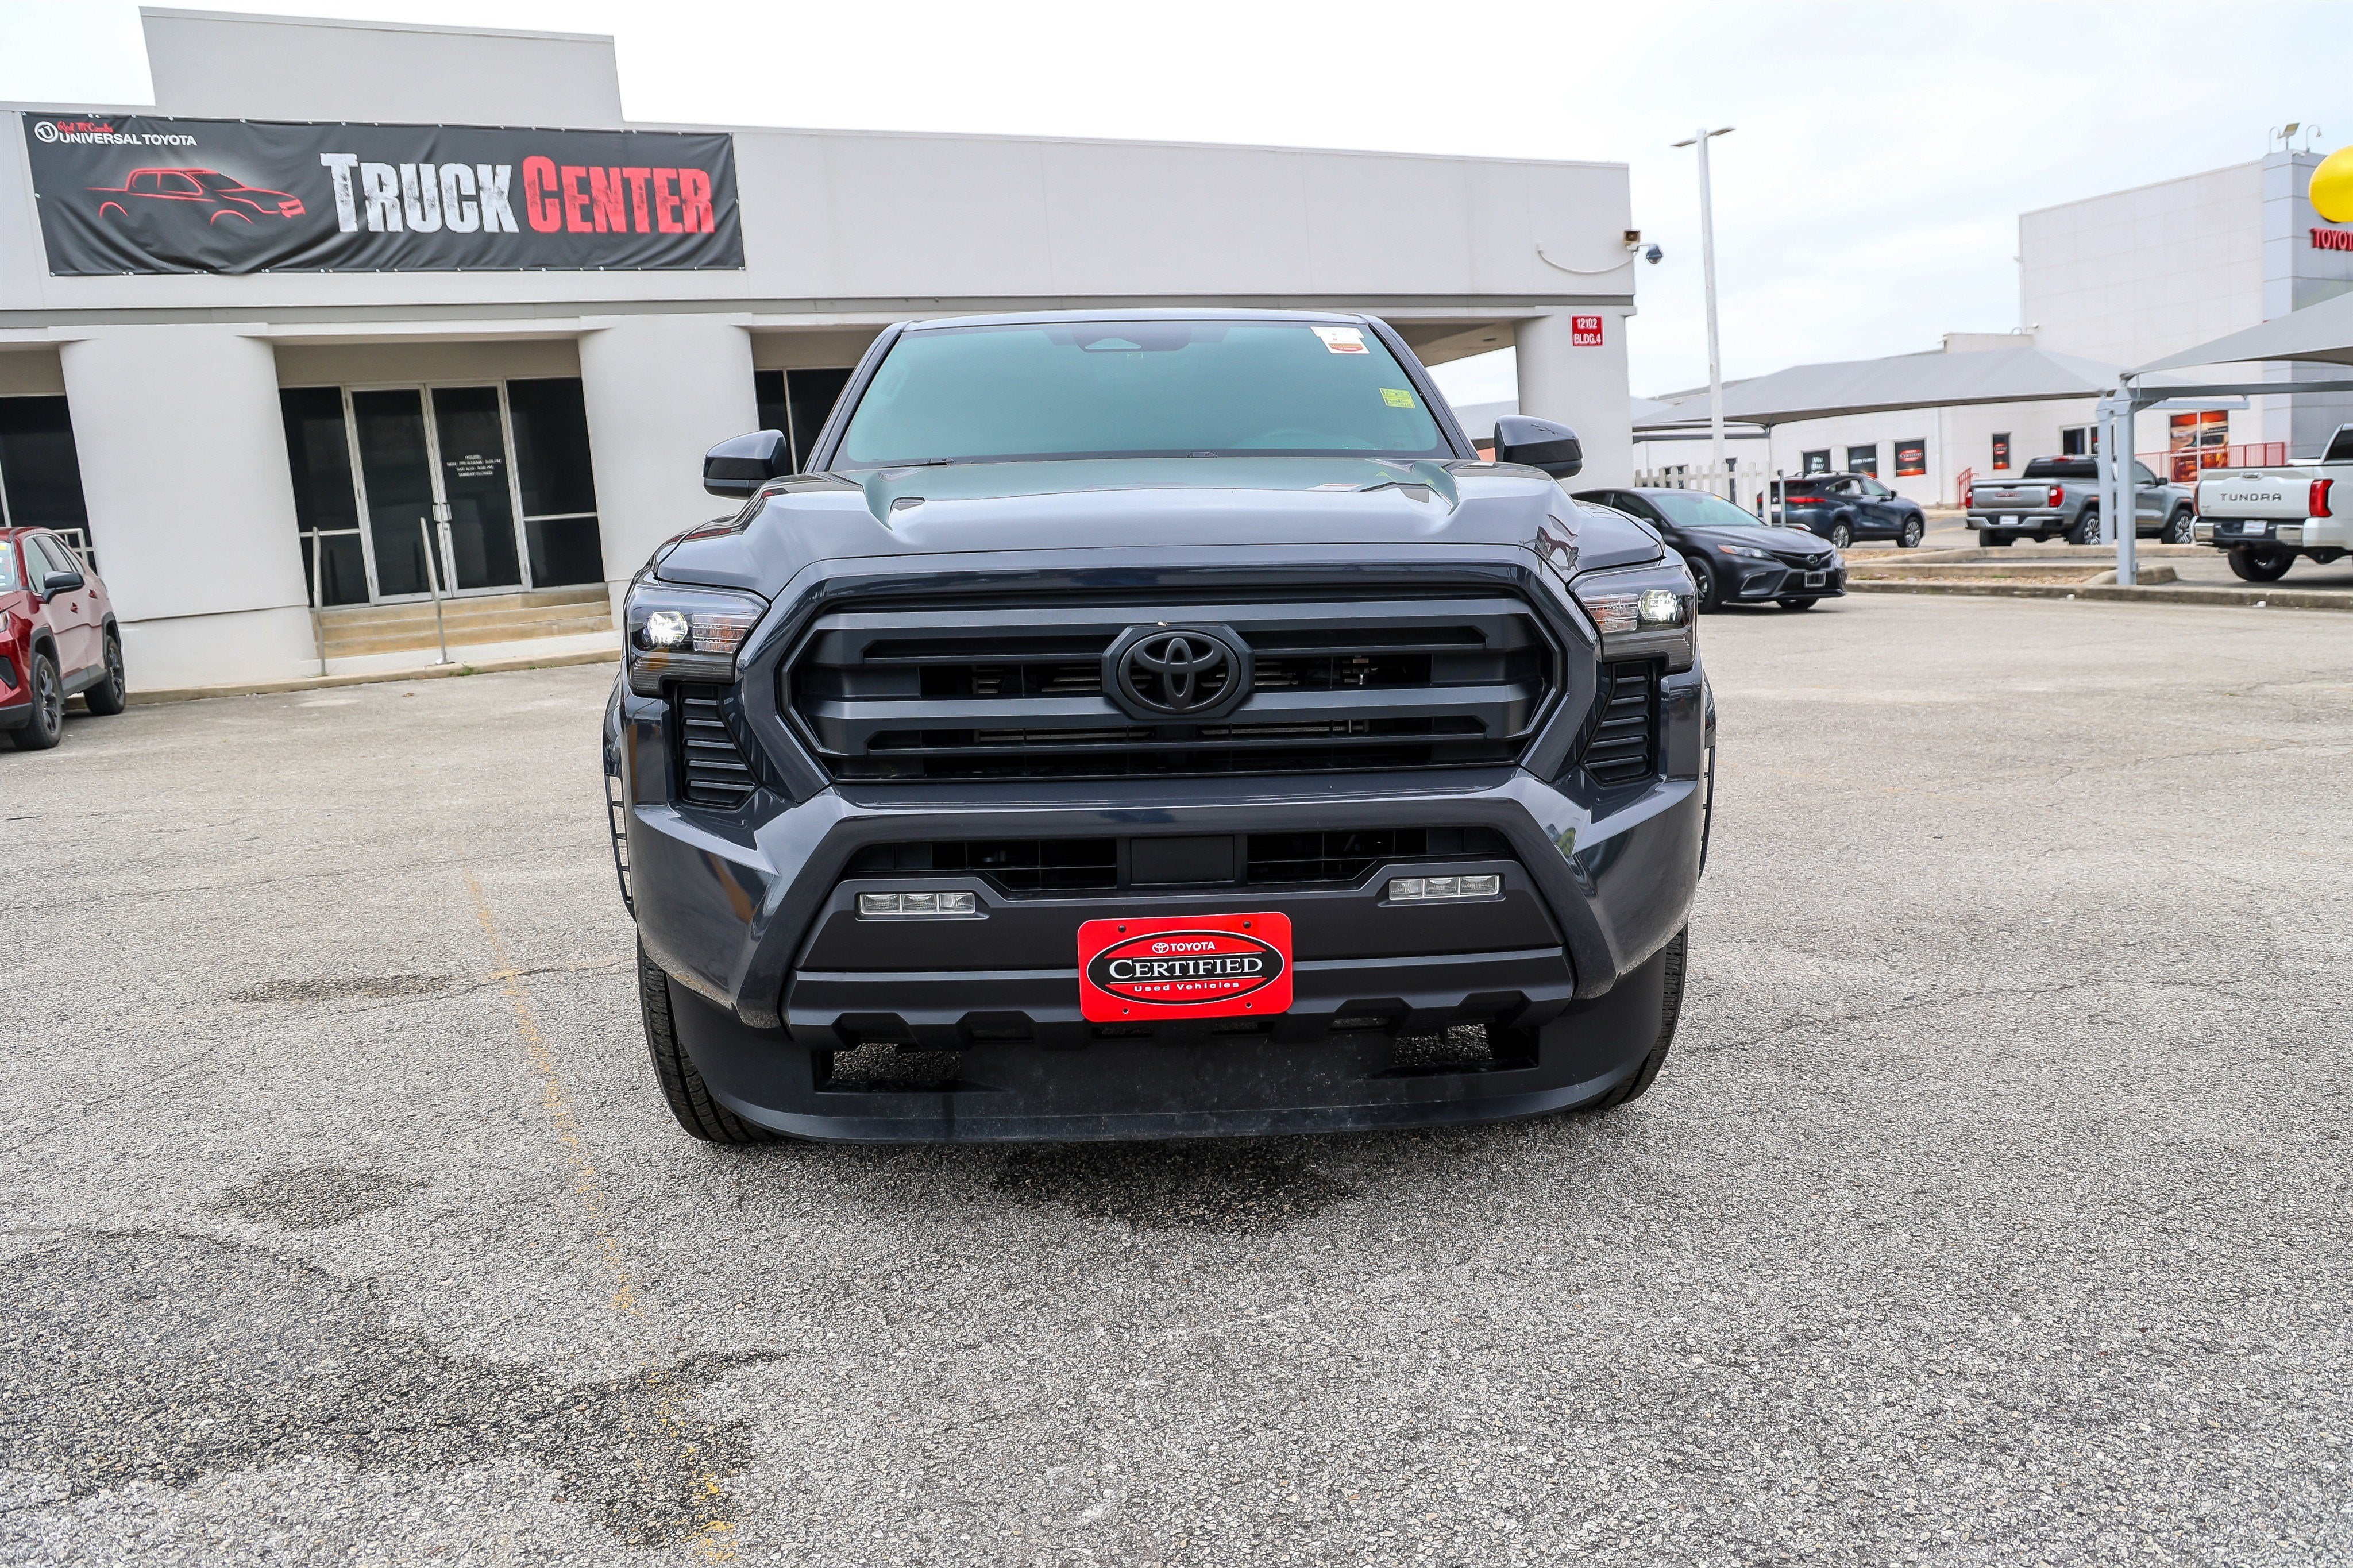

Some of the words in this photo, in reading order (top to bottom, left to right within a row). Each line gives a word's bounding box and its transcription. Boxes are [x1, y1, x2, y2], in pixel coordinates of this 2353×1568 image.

[59, 132, 142, 145] UNIVERSAL
[141, 134, 198, 146] TOYOTA
[320, 152, 520, 233] TRUCK
[522, 155, 715, 234] CENTER
[1576, 318, 1598, 329] 12102
[2220, 493, 2282, 501] TUNDRA
[1171, 941, 1216, 952] TOYOTA
[1109, 957, 1263, 979] CERTIFIED
[1134, 984, 1170, 992] Used
[1176, 982, 1239, 991] Vehicles
